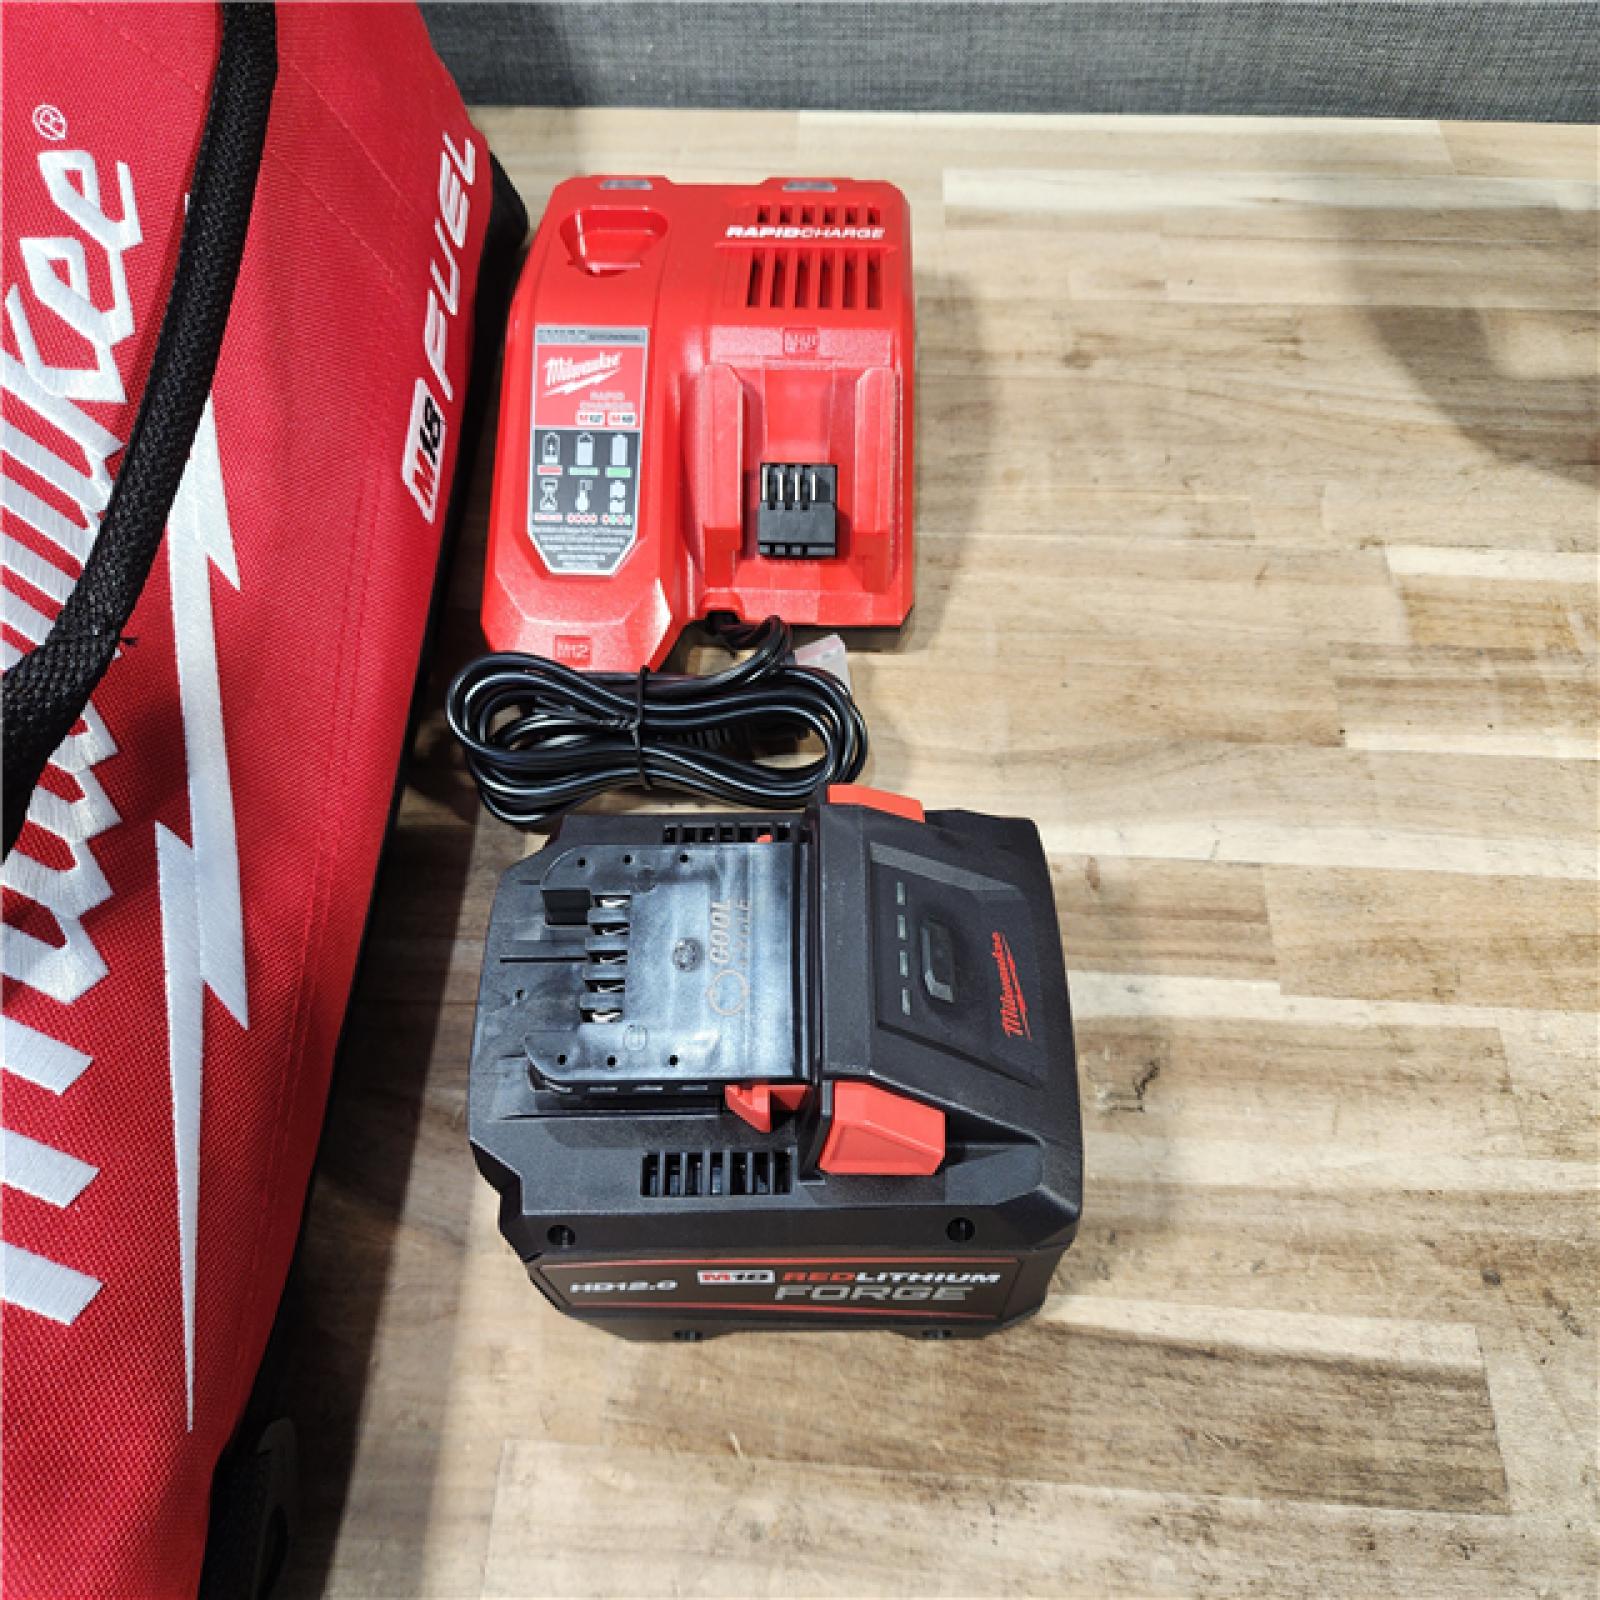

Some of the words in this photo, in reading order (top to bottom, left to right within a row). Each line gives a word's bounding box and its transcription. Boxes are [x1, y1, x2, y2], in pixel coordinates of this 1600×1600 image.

[726, 225, 885, 239] RAPIDCHARGE
[423, 130, 476, 402] FUEL
[405, 384, 446, 520] M18
[783, 1272, 1001, 1284] REDLITHIUM
[570, 1280, 679, 1293] HD12.0
[774, 1284, 974, 1301] FORGE
